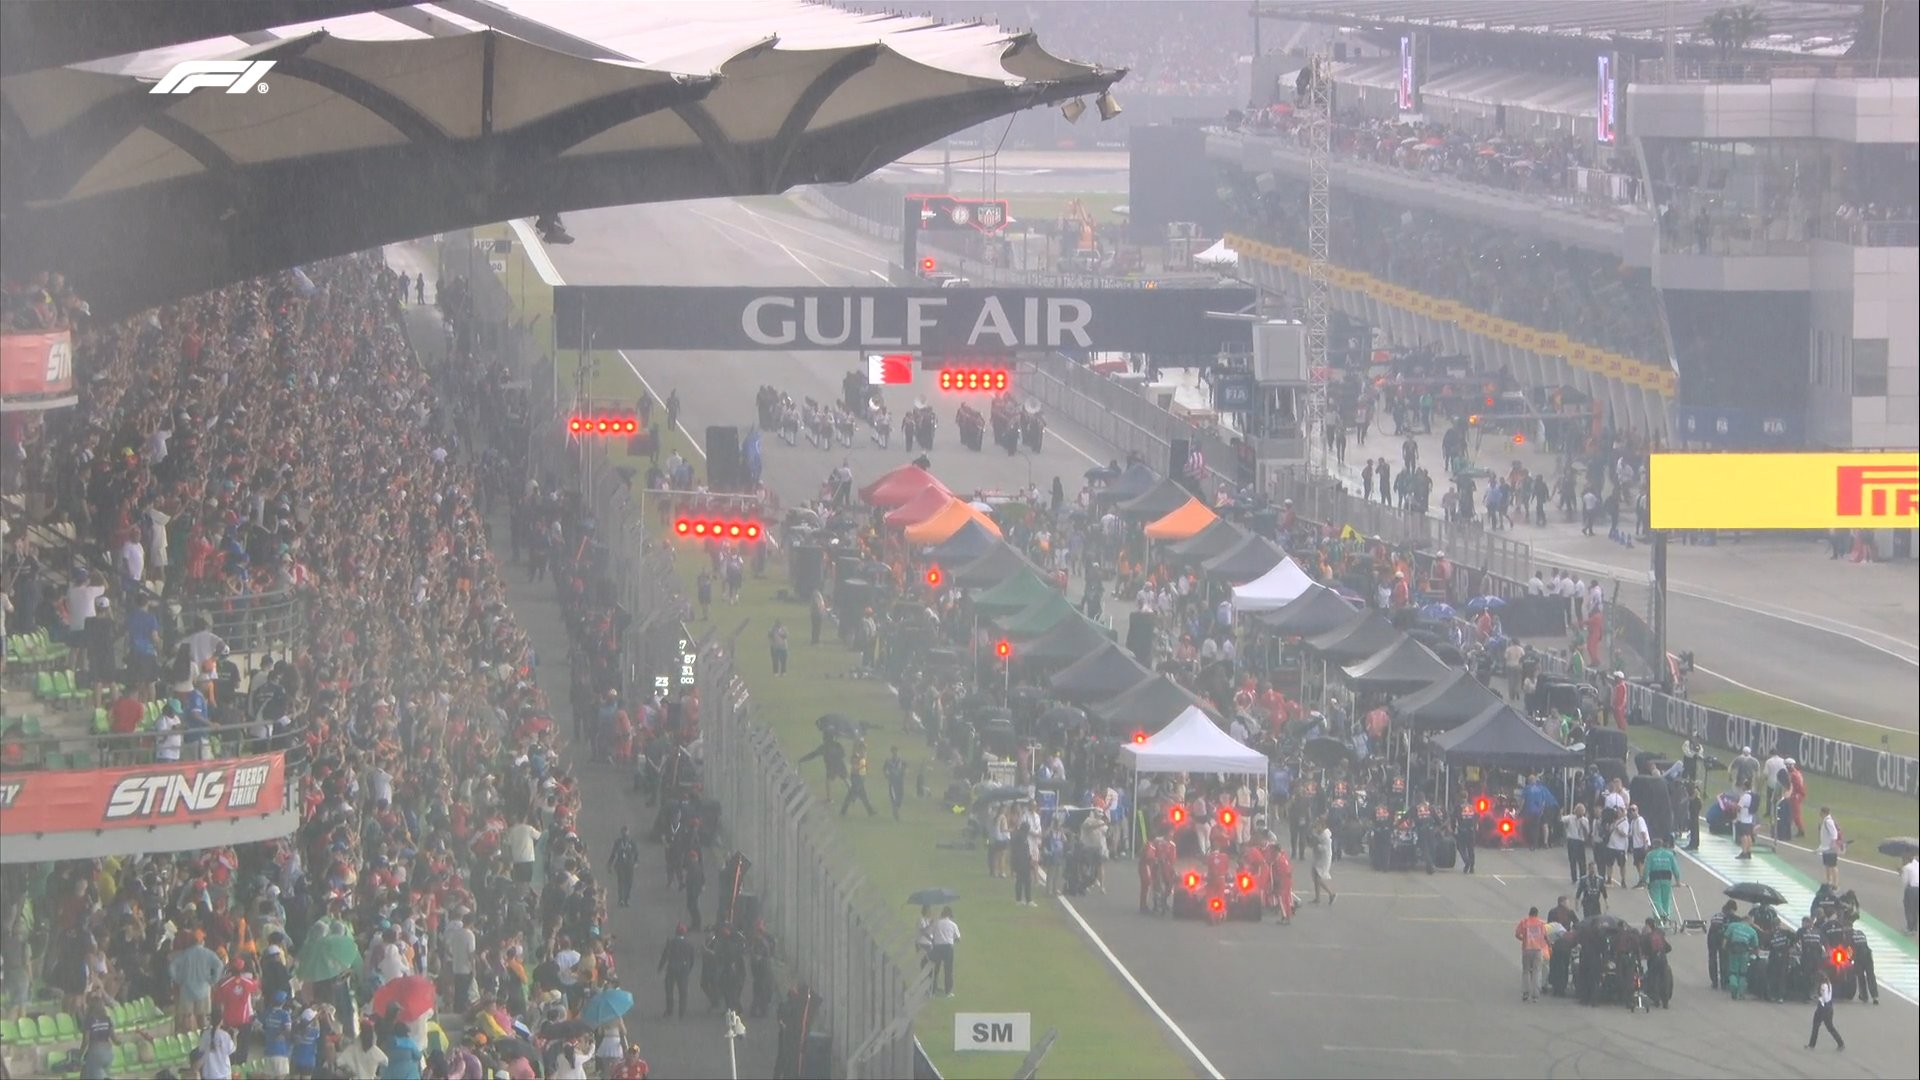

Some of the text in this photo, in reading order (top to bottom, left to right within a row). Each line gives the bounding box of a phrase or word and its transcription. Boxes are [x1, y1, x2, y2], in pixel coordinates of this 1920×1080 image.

[742, 295, 1093, 347] GULF AIR
[1799, 732, 1853, 780] GULF AIR
[1877, 751, 1912, 793] GULF
[106, 765, 269, 817] STING ENERGY
[228, 786, 259, 807] DRINK
[972, 1022, 1013, 1043] SM
